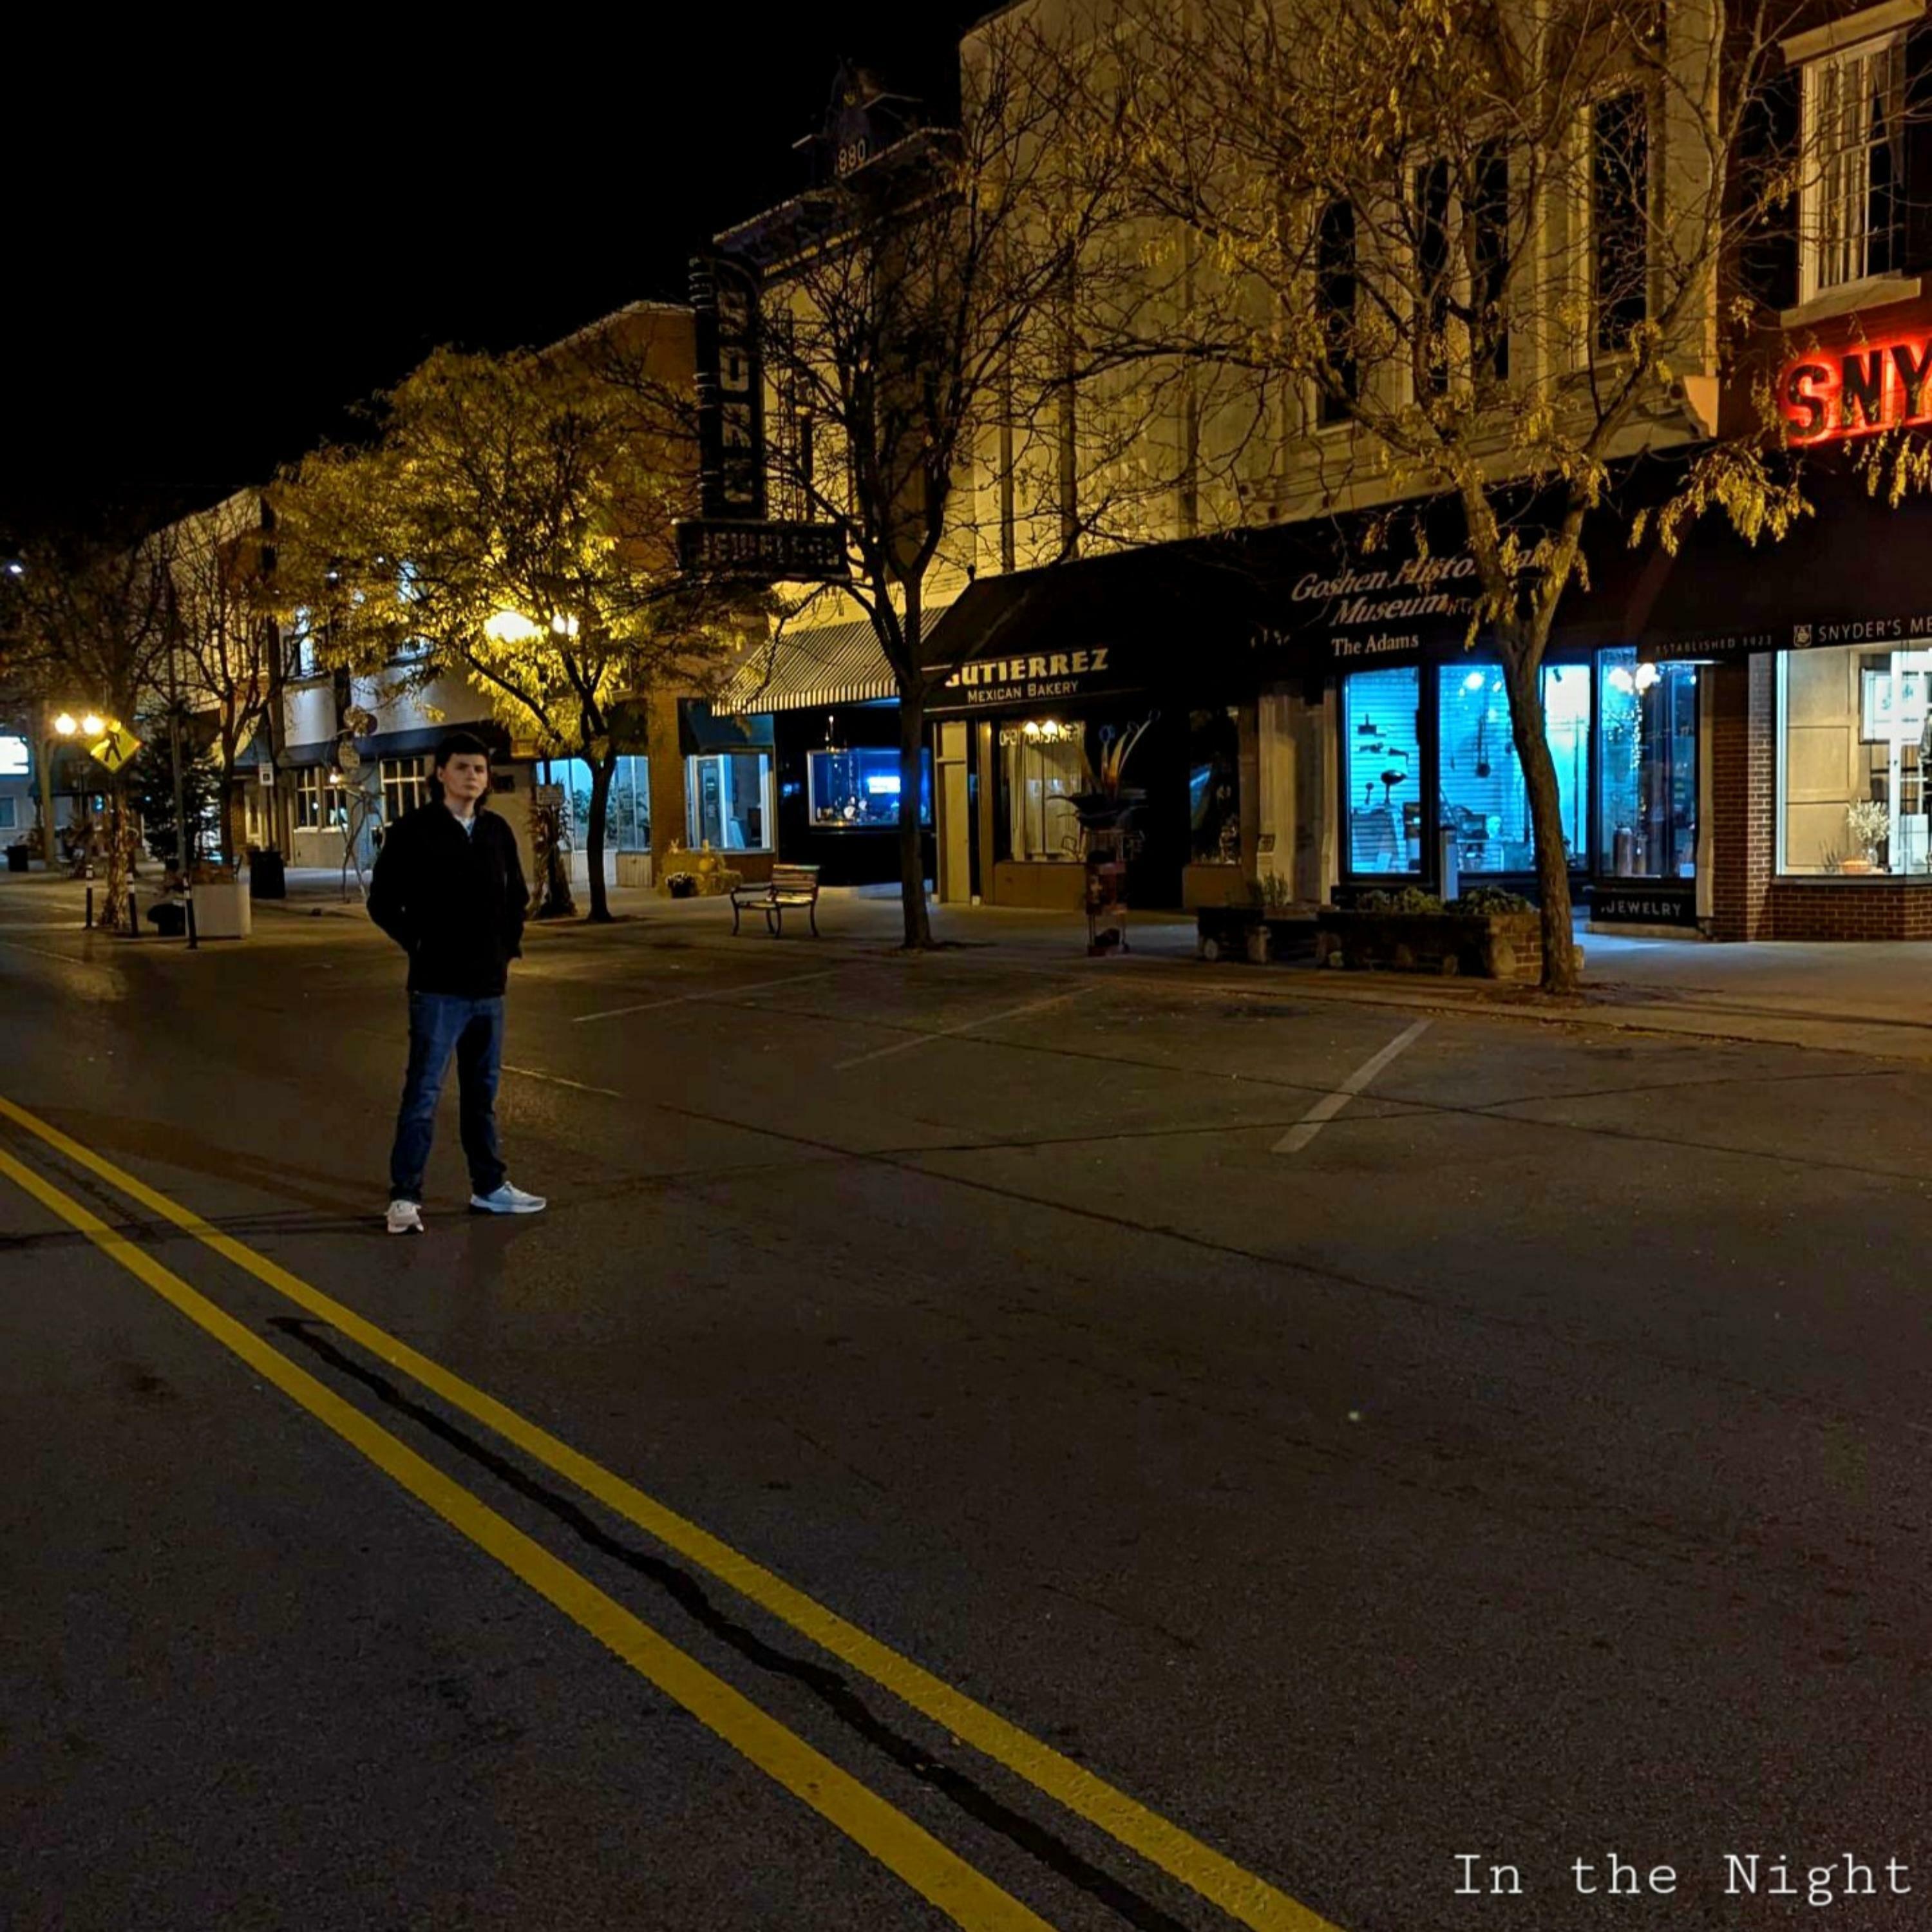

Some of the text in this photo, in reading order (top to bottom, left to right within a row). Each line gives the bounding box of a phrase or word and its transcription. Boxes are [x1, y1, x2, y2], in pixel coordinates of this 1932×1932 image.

[1788, 339, 1932, 437] SNY
[1291, 567, 1388, 601] Goshen
[1328, 593, 1449, 627] Museum
[1817, 619, 1902, 643] SNYDER'S
[1331, 633, 1419, 657] The Adams
[1027, 681, 1079, 697] BAKERY
[1605, 899, 1682, 918] JEWELRY
